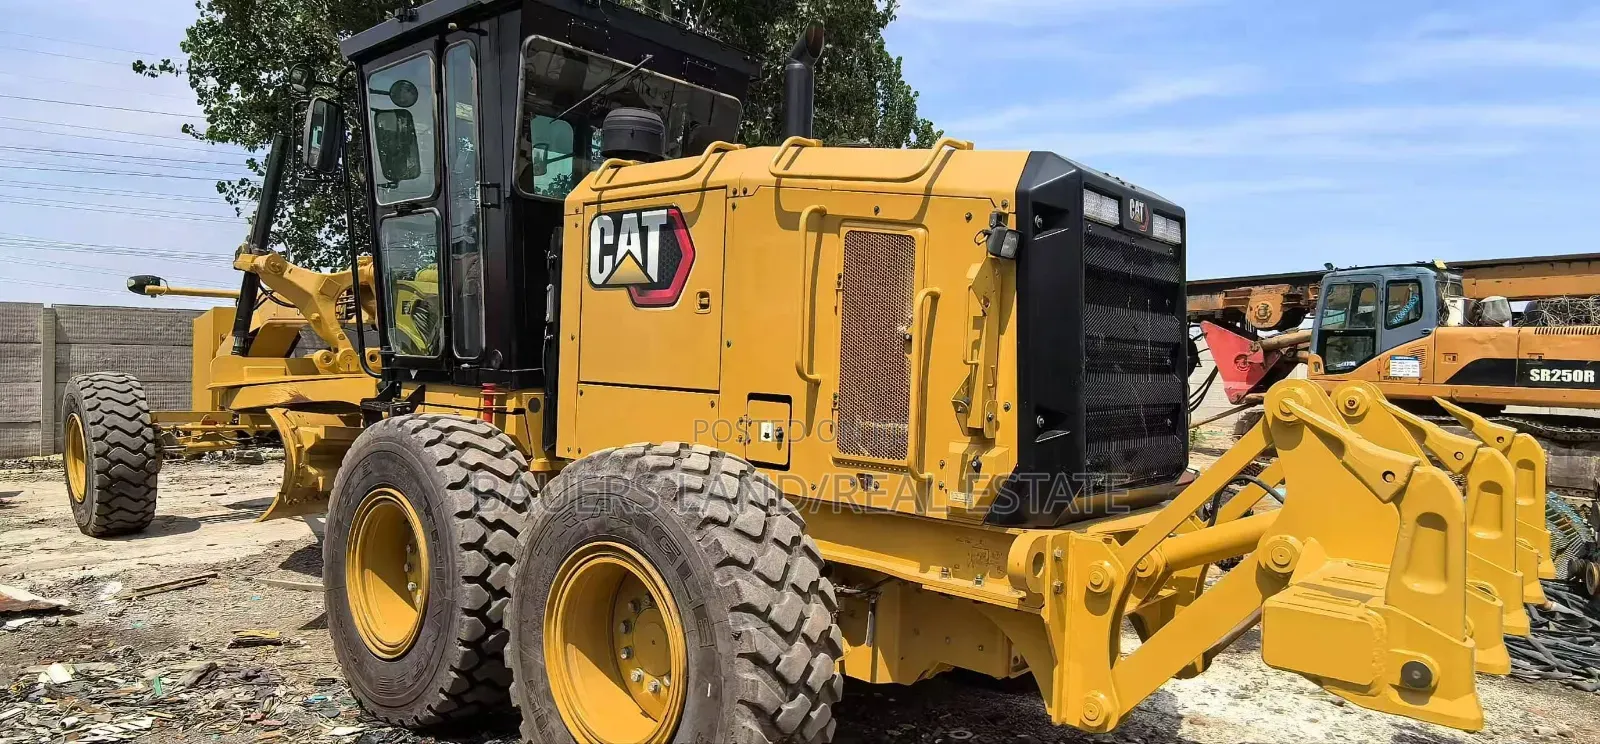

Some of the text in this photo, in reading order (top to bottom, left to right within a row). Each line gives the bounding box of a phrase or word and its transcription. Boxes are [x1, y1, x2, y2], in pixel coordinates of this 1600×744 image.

[1129, 198, 1145, 224] CAT
[590, 208, 668, 285] CAT
[1529, 368, 1595, 383] SR250R
